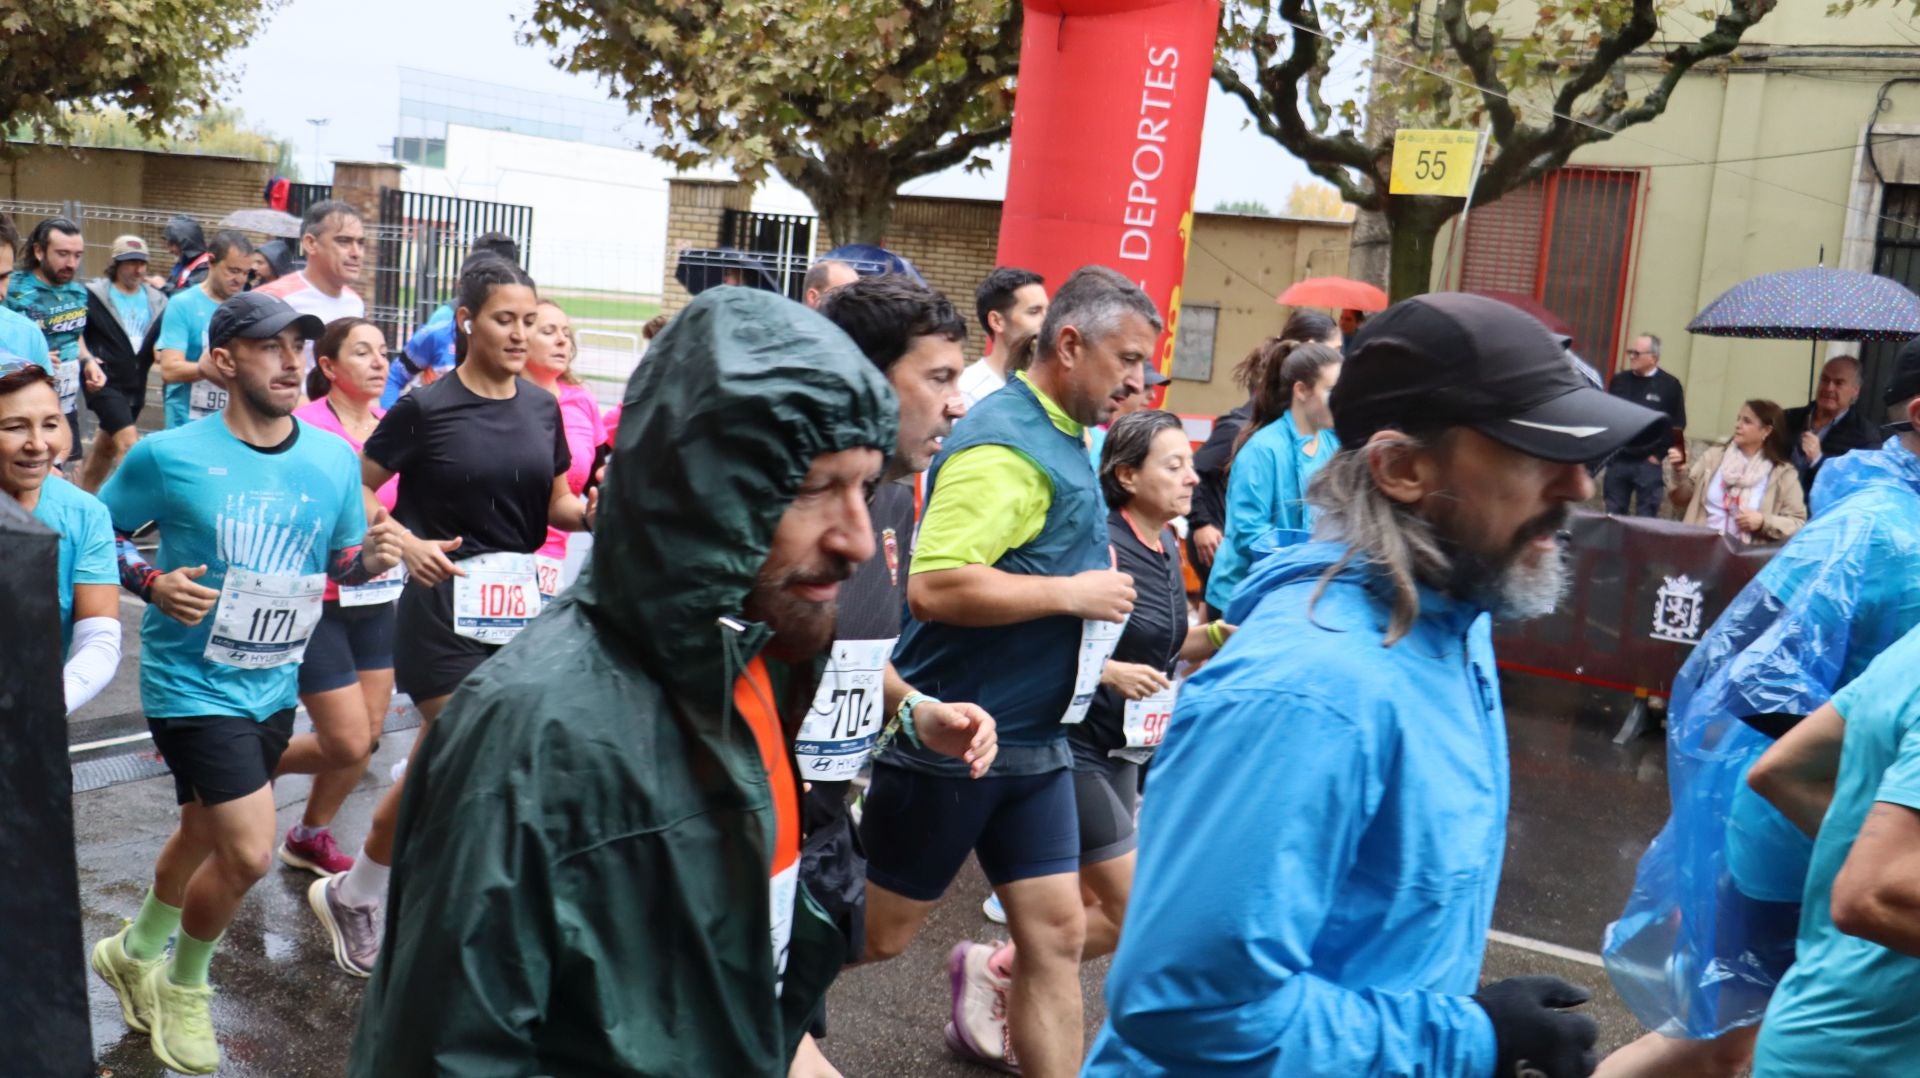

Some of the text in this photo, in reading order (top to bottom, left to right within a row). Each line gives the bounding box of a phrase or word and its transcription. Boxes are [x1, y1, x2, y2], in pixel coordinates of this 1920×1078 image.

[1119, 46, 1180, 261] DEPORTES
[1415, 151, 1447, 180] 55
[207, 391, 226, 409] 96
[480, 584, 526, 616] 1018
[248, 608, 297, 641] 1171
